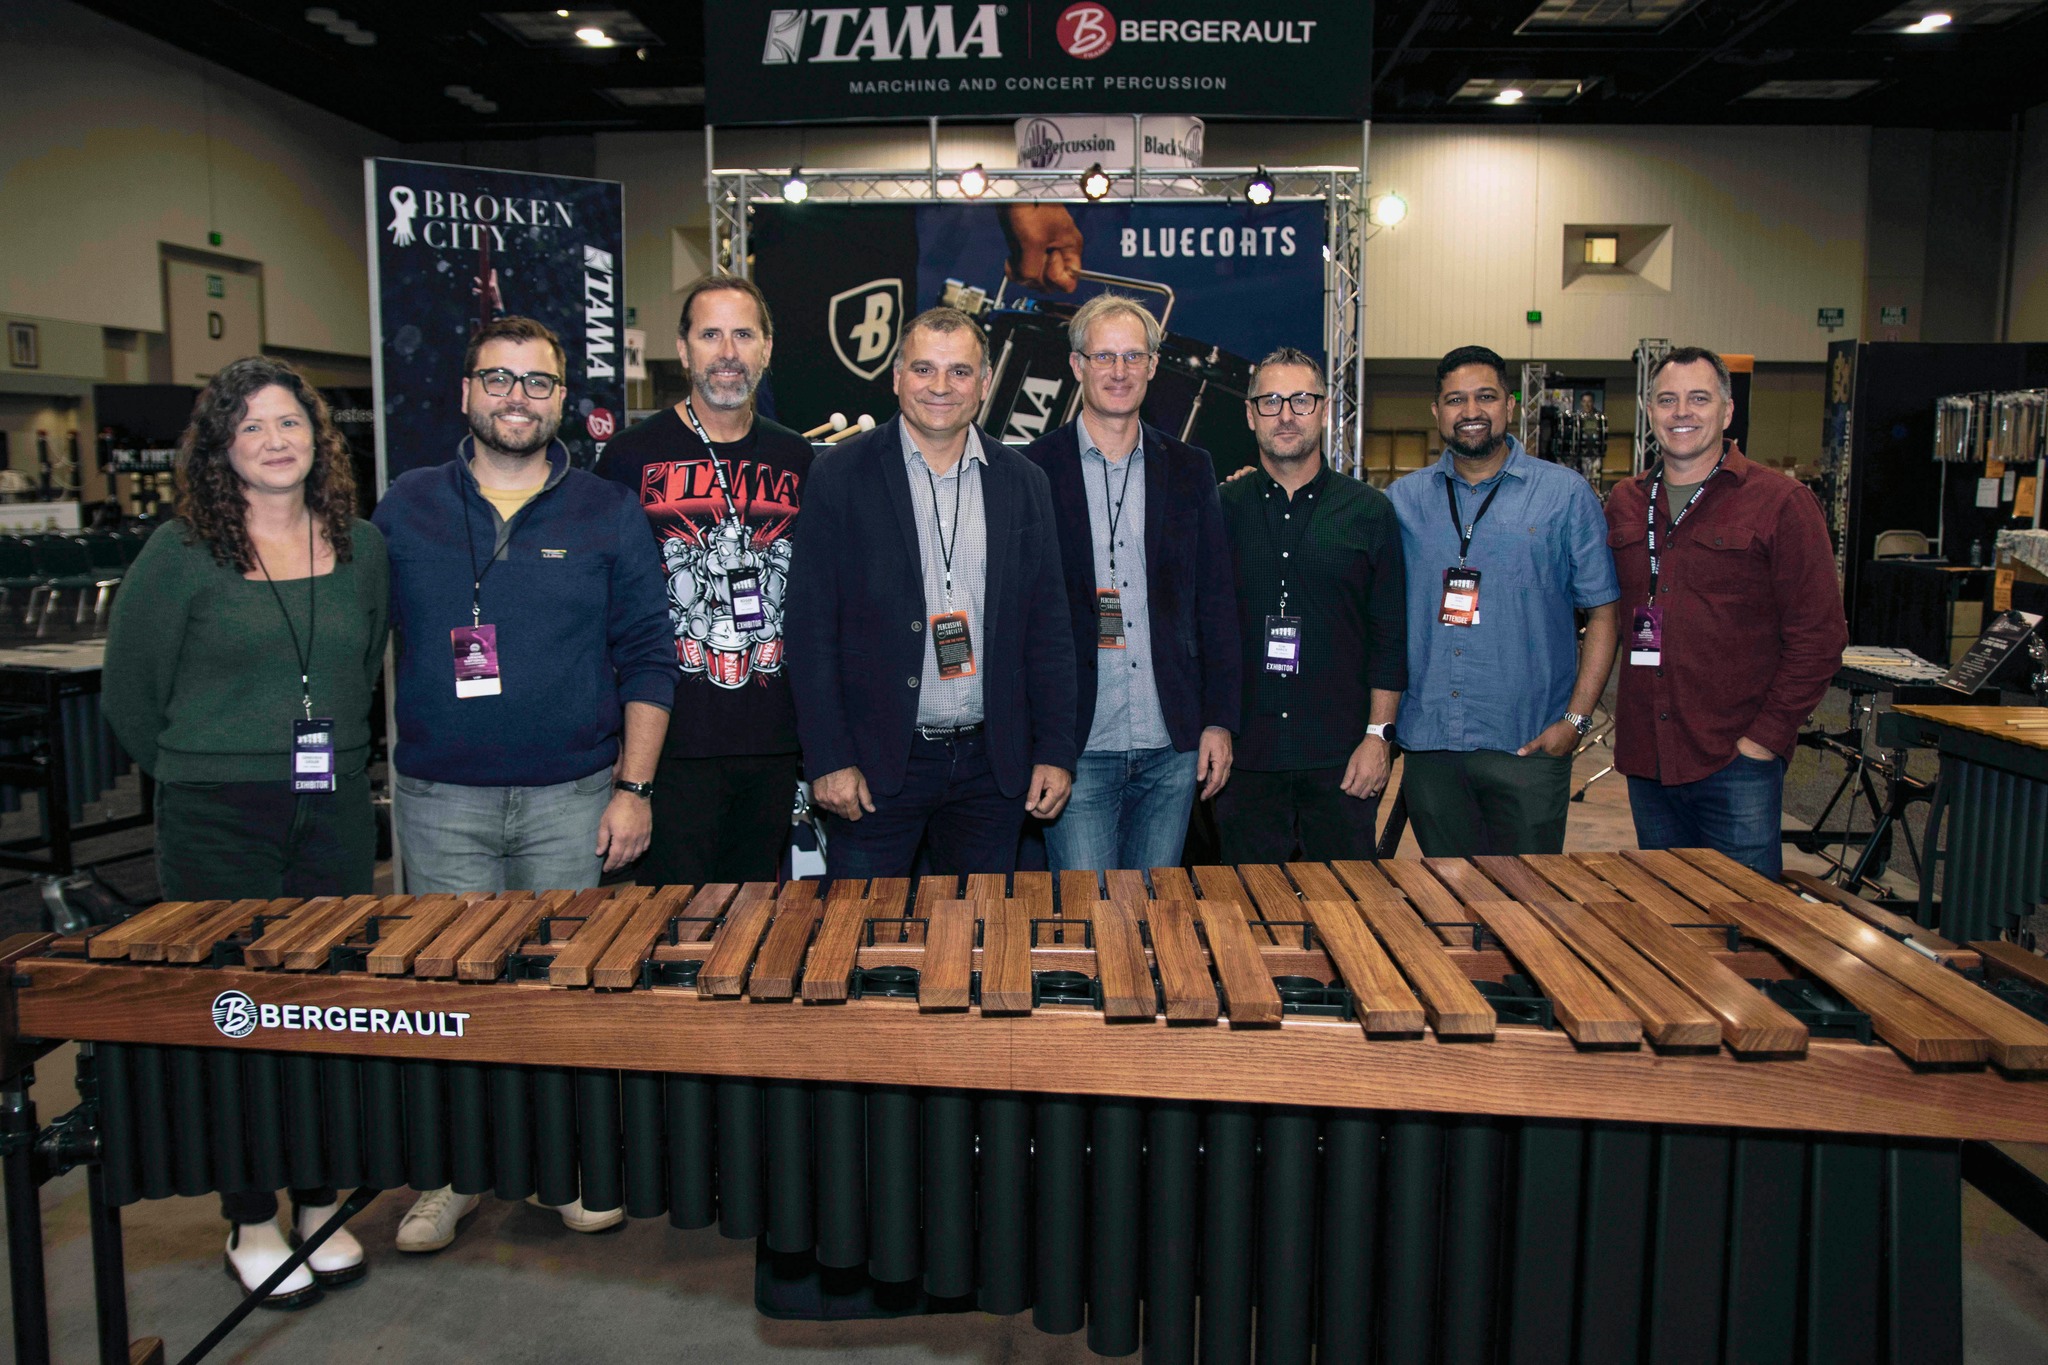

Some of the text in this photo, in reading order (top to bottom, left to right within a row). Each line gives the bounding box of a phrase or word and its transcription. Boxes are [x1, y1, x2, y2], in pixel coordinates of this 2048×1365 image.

[808, 4, 1003, 62] TAMA
[1120, 20, 1317, 43] BERGERAULT
[850, 76, 1227, 94] MARCHING AND CONCERT PERCUSSION
[1045, 134, 1115, 155] Percussion
[1144, 135, 1176, 156] Black
[423, 220, 511, 252] CITY
[1120, 226, 1296, 258] BLUECOATS
[584, 271, 616, 380] TAMA
[673, 460, 800, 509] TAMA
[936, 620, 963, 631] PERCUSSIVE
[1442, 613, 1469, 624] ATTENDEE
[1266, 662, 1294, 673] EXHIBITOR
[295, 780, 330, 790] EXHIBITOR
[260, 1003, 471, 1037] BERGERAULT
